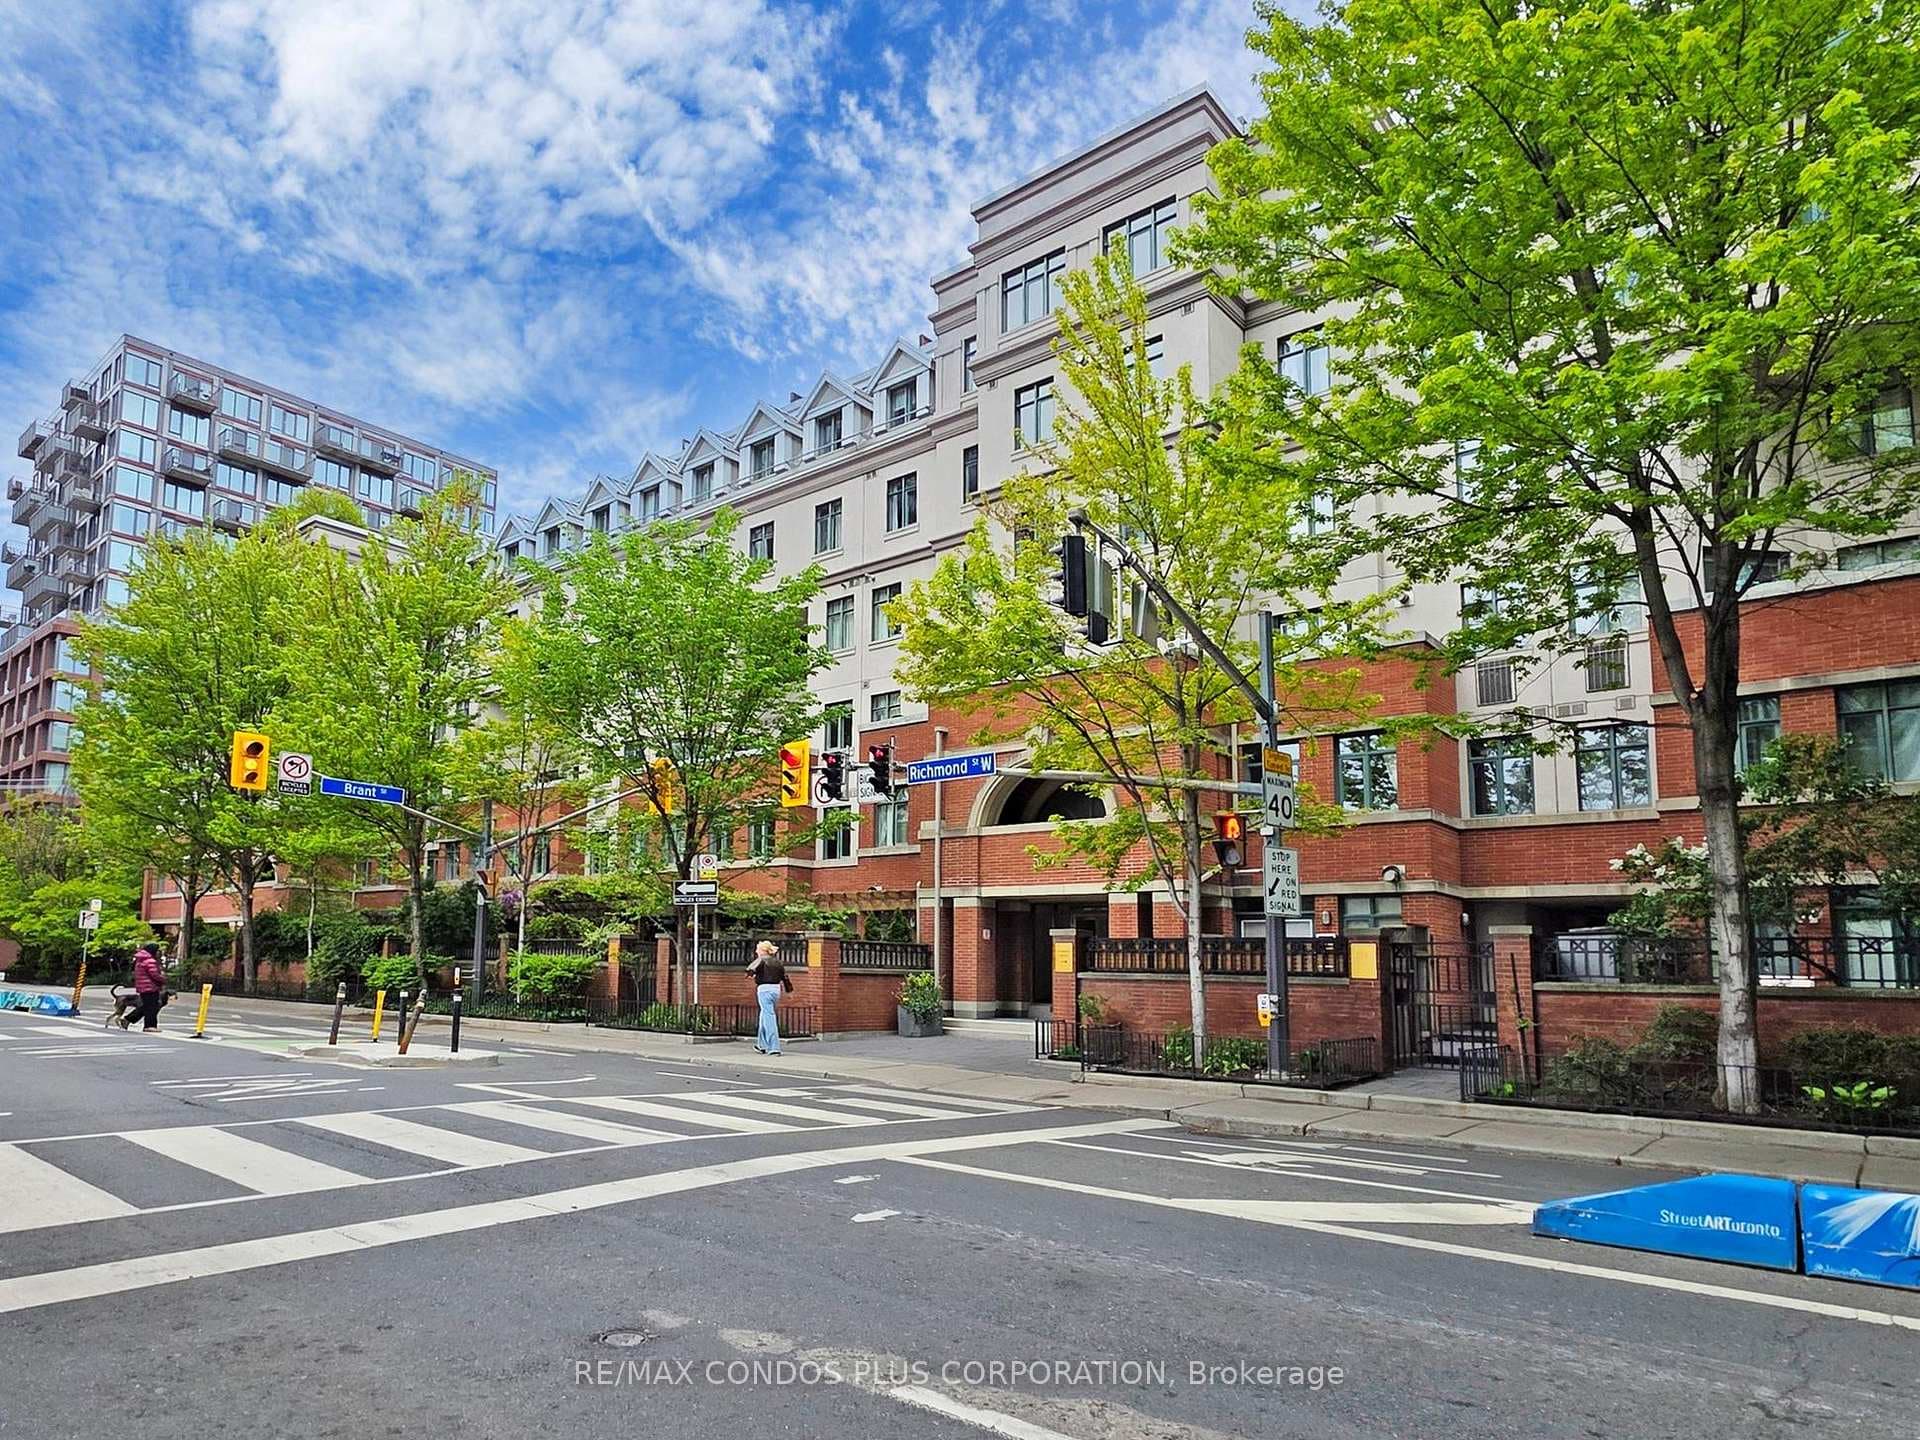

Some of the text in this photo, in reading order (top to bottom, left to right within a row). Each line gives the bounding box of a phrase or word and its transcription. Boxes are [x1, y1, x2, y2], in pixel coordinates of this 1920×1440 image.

[910, 755, 992, 780] Richmond St W
[344, 782, 377, 798] Brant
[1269, 793, 1292, 819] 40
[1272, 851, 1291, 861] STOP
[1271, 864, 1292, 874] HERE
[1285, 877, 1297, 887] ON
[1281, 889, 1297, 899] RED
[1270, 900, 1297, 912] SIGNAL
[1660, 1209, 1780, 1237] StreetARToronto
